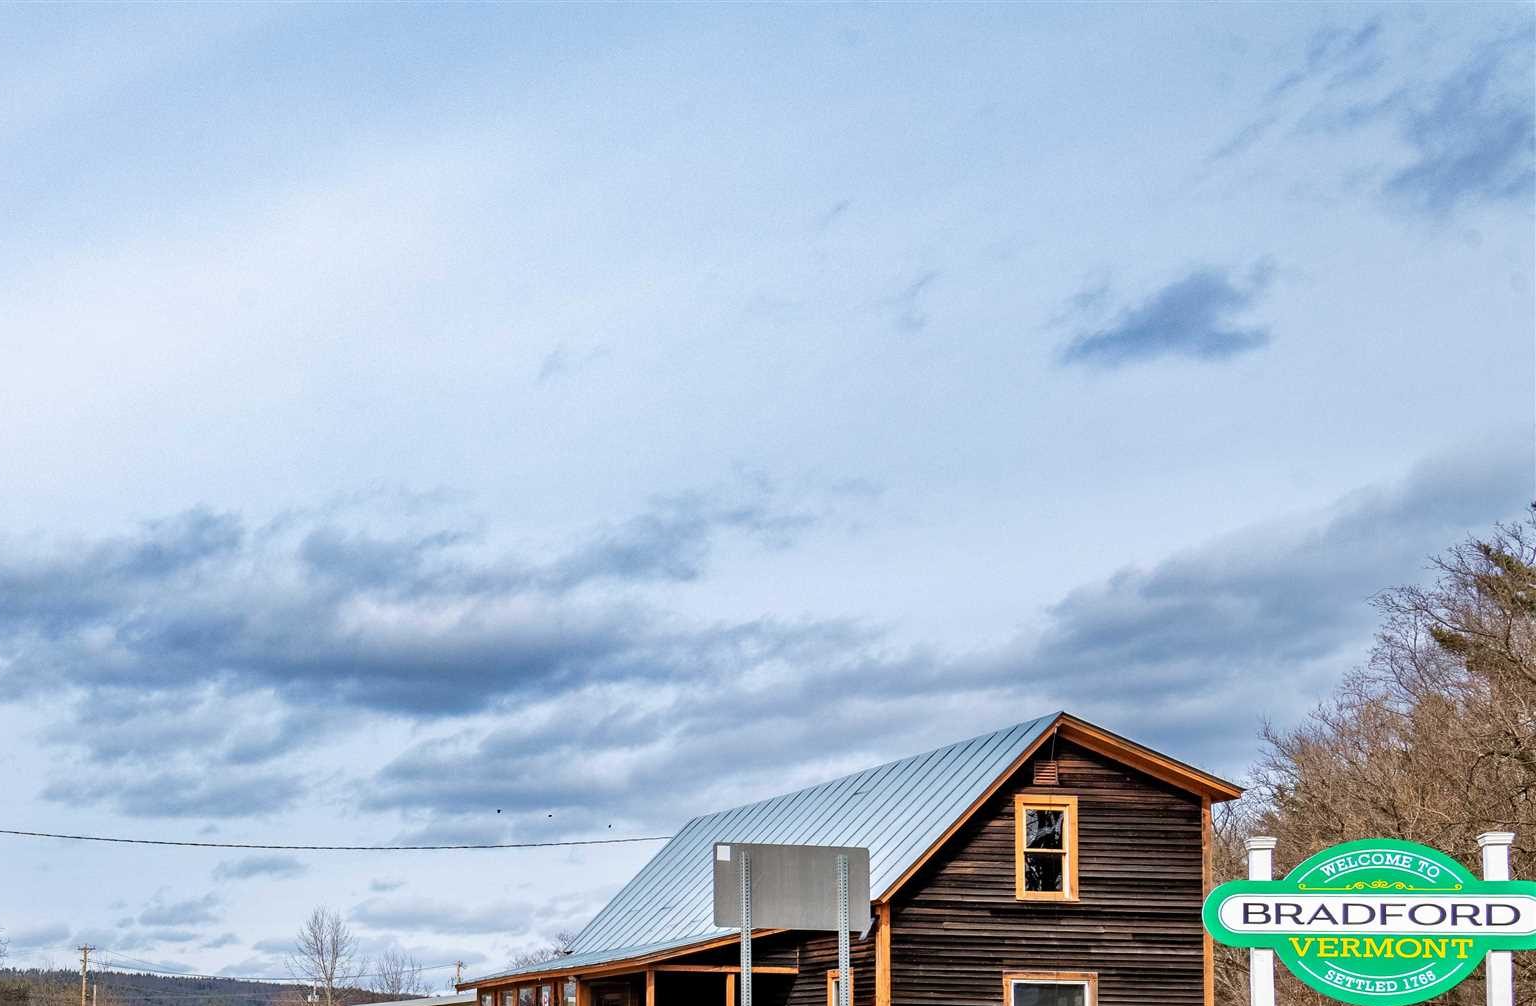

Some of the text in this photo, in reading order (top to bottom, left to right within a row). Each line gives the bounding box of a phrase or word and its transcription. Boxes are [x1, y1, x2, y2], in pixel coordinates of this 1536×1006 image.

[1320, 853, 1441, 878] WELCOME TO
[1242, 902, 1521, 927] BRADFORD
[1288, 937, 1474, 960] VERMONT
[1325, 969, 1399, 992] SETTLED
